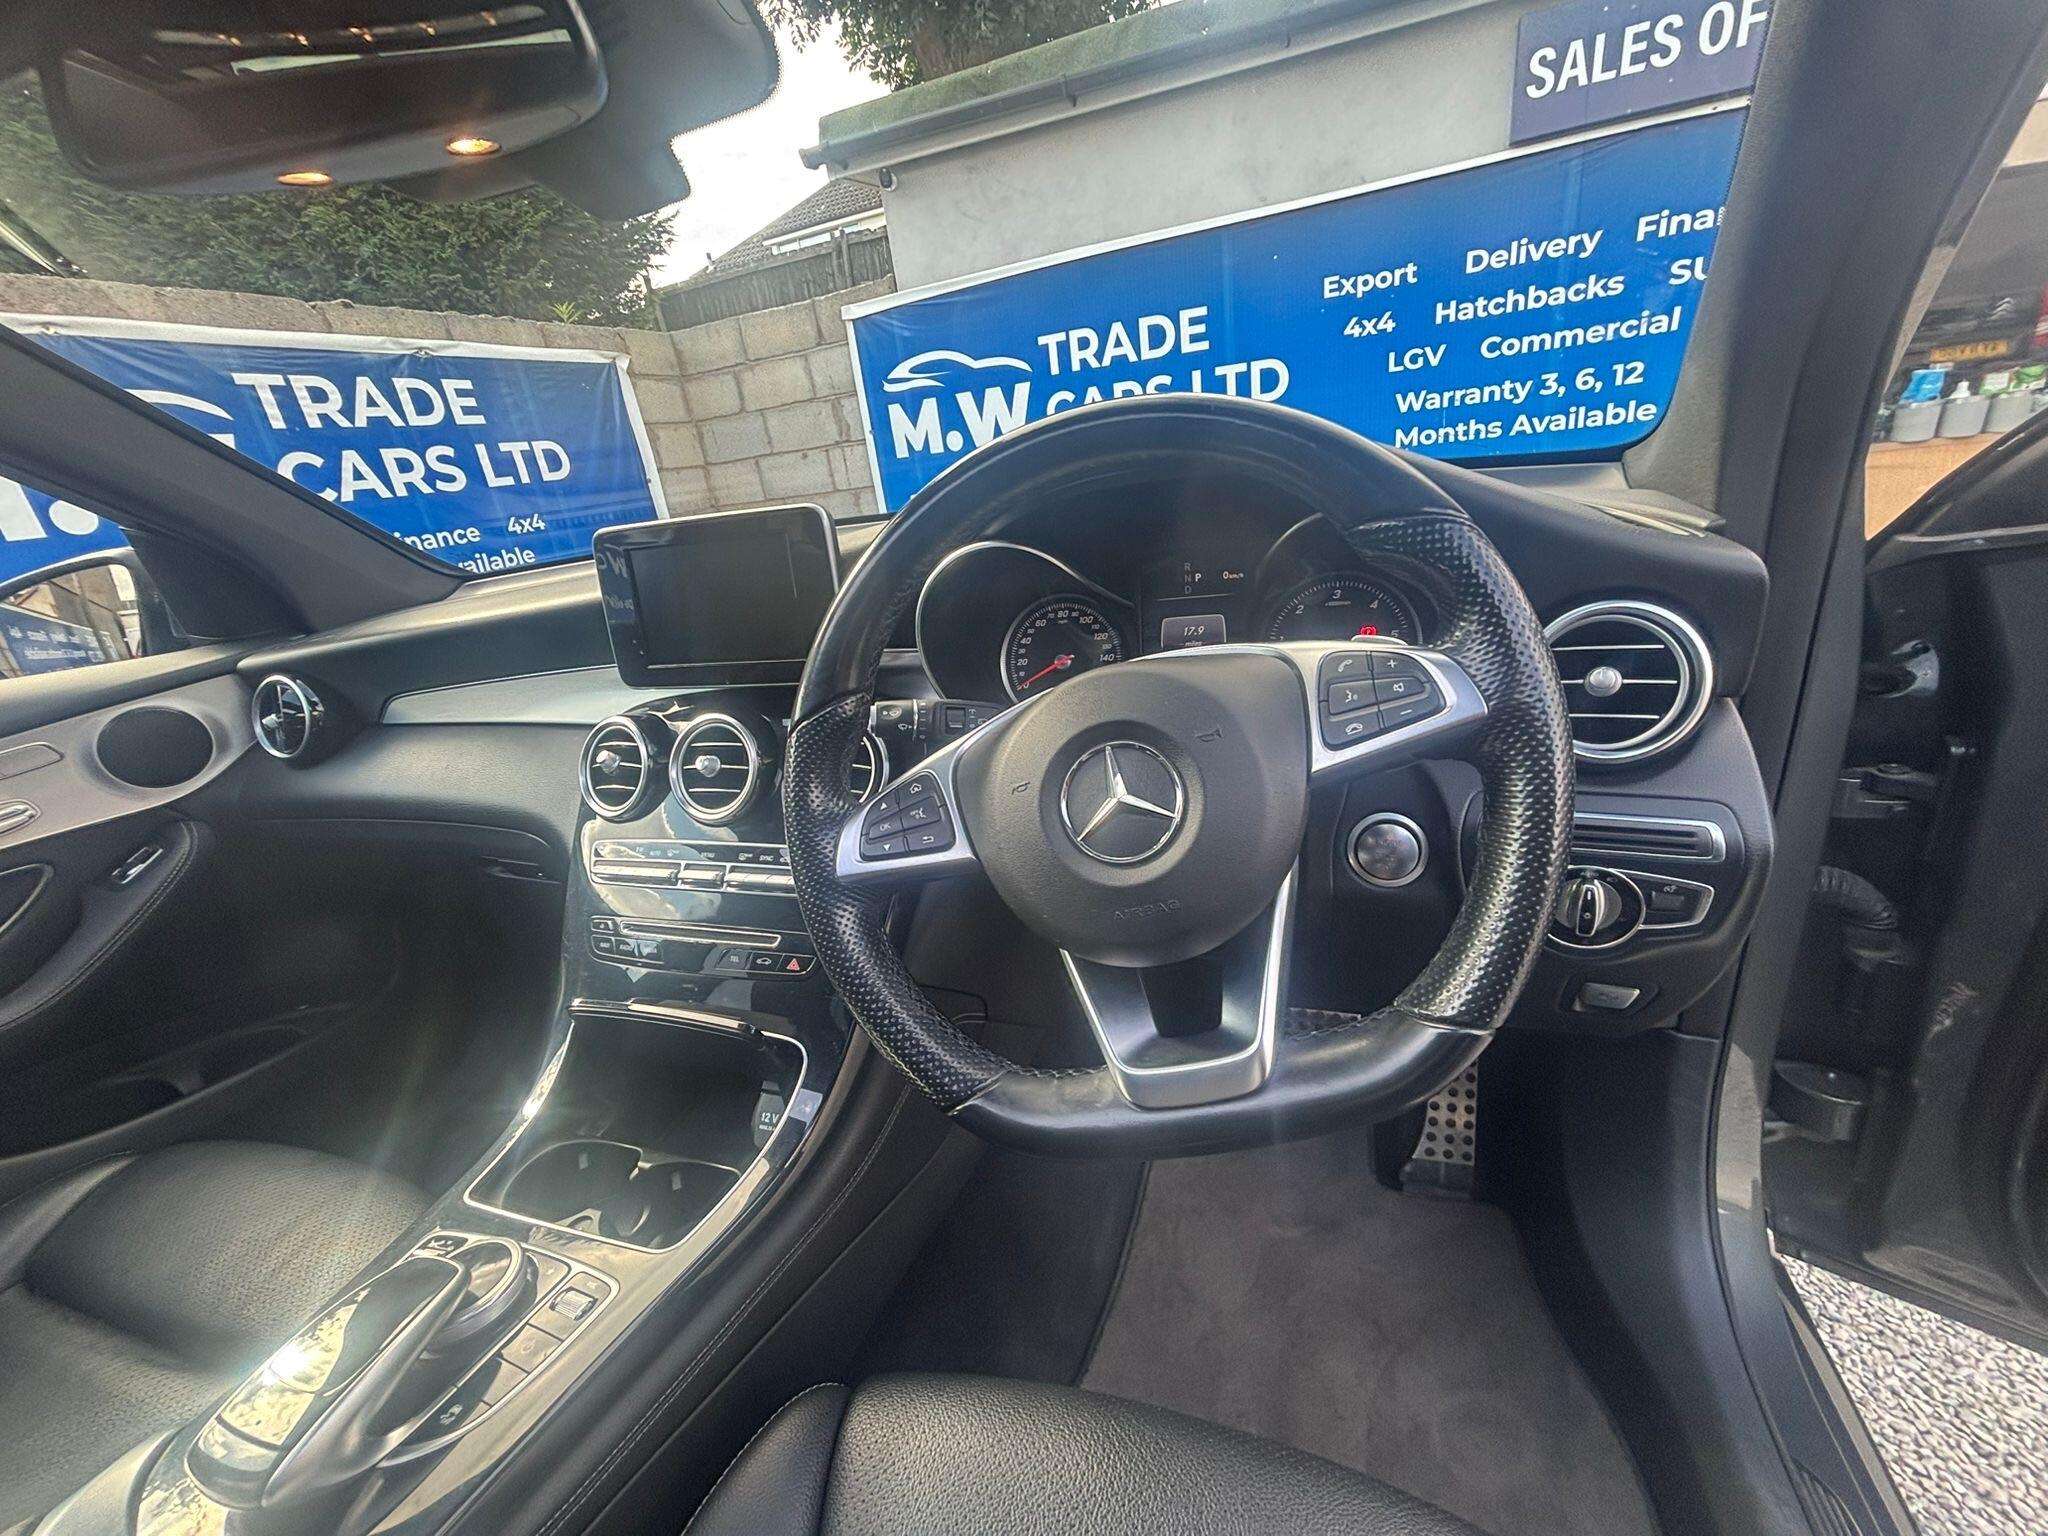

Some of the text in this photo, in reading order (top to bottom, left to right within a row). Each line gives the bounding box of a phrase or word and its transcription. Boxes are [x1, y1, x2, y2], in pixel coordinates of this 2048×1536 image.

[1525, 13, 1685, 99] SALES
[1464, 228, 1604, 275] Delivery
[1322, 261, 1418, 301] Export
[1434, 273, 1626, 326] Hatchbacks
[1342, 311, 1397, 338] 4x4
[1479, 306, 1682, 359] Commercial
[1037, 305, 1211, 377] TRADE
[1387, 344, 1447, 373] LGV
[1395, 361, 1645, 414] Warranty 3, 6, 12
[230, 372, 487, 430] TRADE
[1394, 397, 1658, 449] Months Available
[276, 439, 571, 502] CARS LTD
[507, 513, 546, 535] 4x4
[1195, 572, 1202, 581] P
[1332, 589, 1342, 599] 3
[1369, 599, 1379, 609] 4
[1057, 610, 1069, 618] 80
[1079, 615, 1094, 624] 100
[1295, 604, 1305, 615] 2
[1035, 619, 1047, 627] 60
[1184, 625, 1205, 636] 17.9
[1021, 637, 1032, 645] 40
[1093, 632, 1109, 640] 120
[1016, 658, 1028, 666] 20
[1100, 653, 1115, 661] 140
